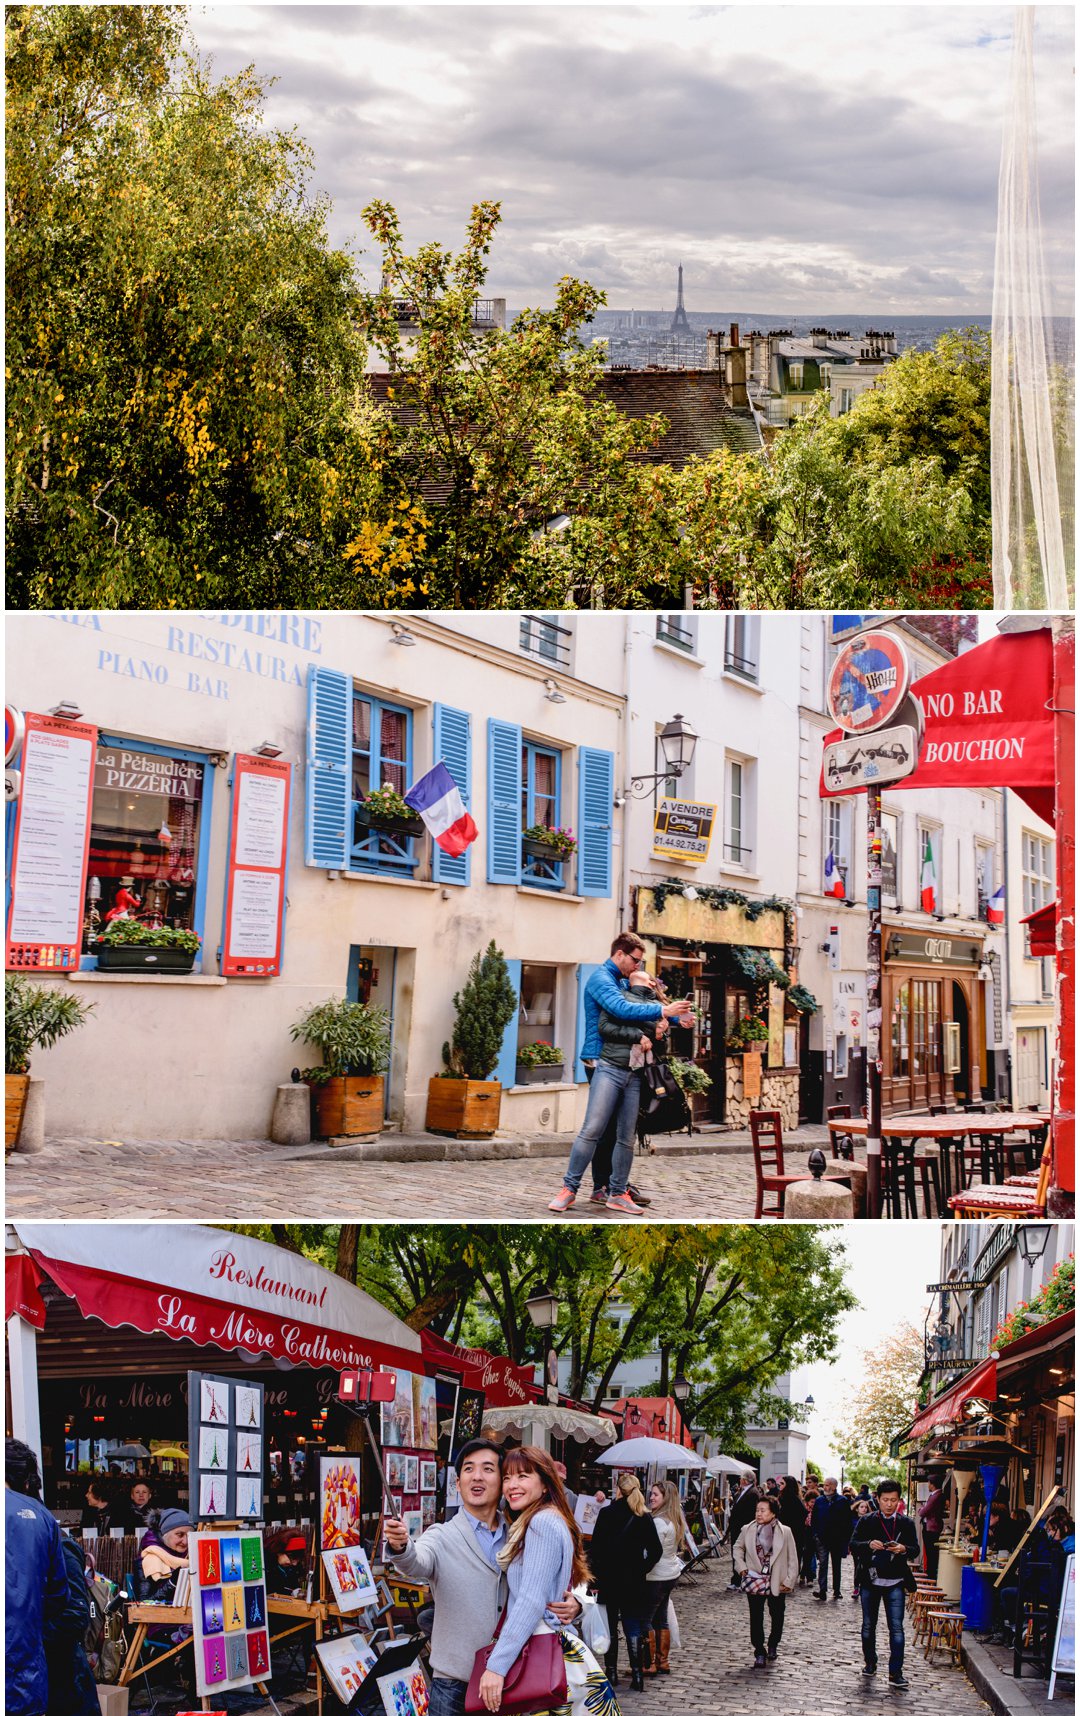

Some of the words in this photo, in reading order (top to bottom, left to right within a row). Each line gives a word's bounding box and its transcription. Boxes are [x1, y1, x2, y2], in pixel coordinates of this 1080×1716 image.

[97, 649, 169, 686] PIANO
[186, 671, 230, 700] BAR
[963, 689, 1004, 716] BAR
[95, 749, 116, 767] La
[924, 737, 1026, 763] BOUCHON
[660, 802, 668, 810] A
[671, 803, 714, 817] VENDRE
[209, 1249, 328, 1308] Restaurant
[157, 1294, 197, 1334] La
[210, 1310, 275, 1349] Mère
[280, 1323, 373, 1368] Catherine
[481, 1364, 500, 1388] Chez
[79, 1384, 108, 1409] La
[119, 1382, 172, 1408] Mère
